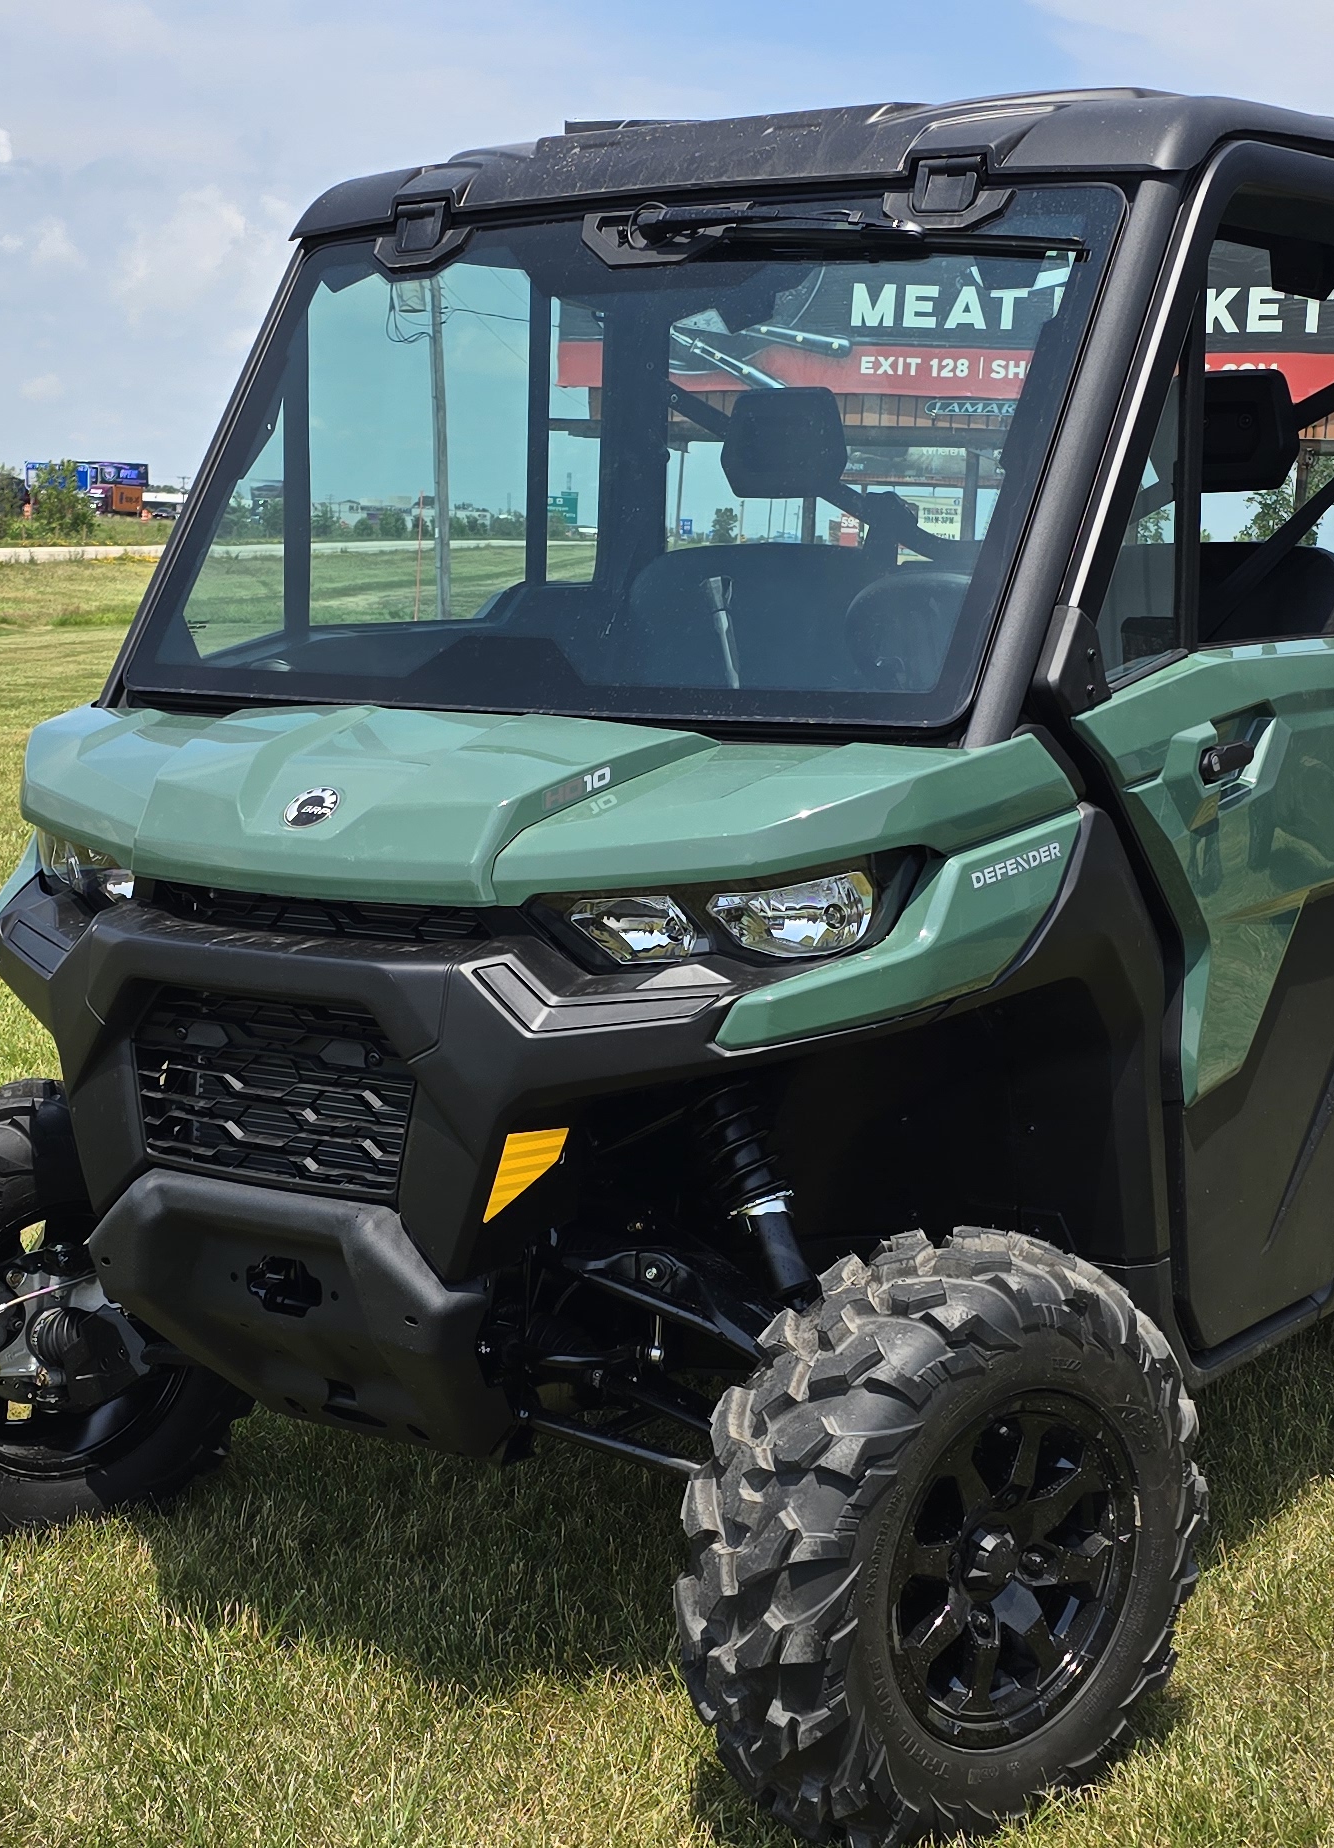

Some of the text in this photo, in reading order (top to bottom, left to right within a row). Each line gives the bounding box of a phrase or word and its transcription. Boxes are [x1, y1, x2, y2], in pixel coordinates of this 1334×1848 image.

[850, 283, 1029, 330] MEAT
[860, 356, 922, 376] EXIT
[929, 357, 970, 378] 128
[934, 401, 1017, 414] LAMAR
[544, 766, 612, 810] HD10
[301, 805, 332, 819] BRP
[971, 842, 1062, 889] DEFENDER
